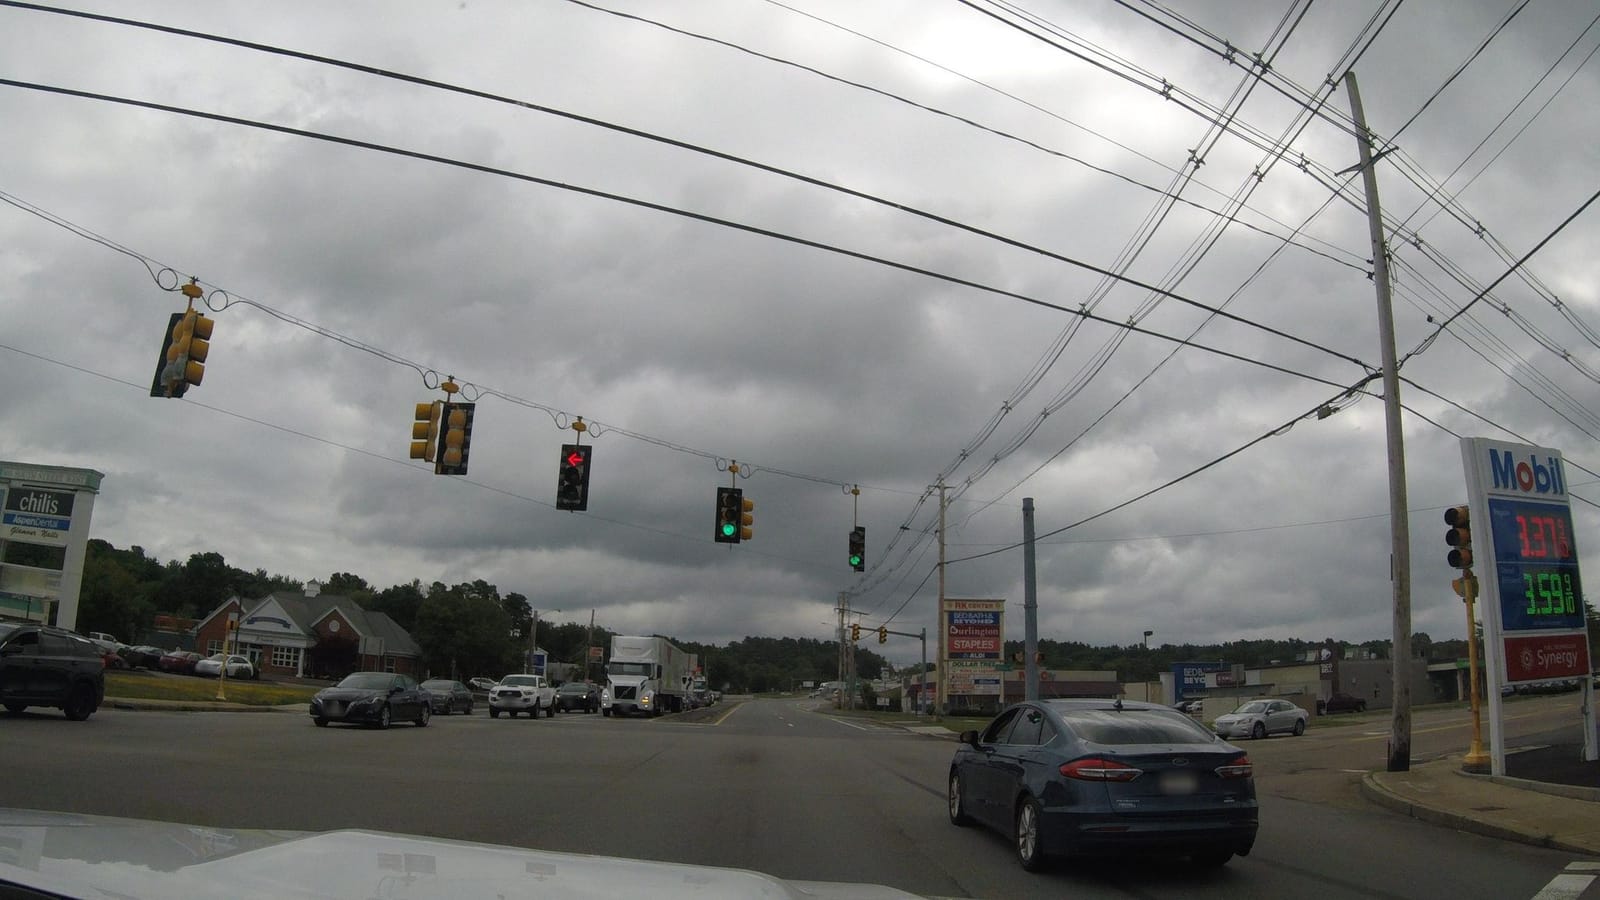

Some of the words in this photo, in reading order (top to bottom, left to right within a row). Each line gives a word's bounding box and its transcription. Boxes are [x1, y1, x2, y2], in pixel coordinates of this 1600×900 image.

[1489, 448, 1564, 495] Mobil
[1516, 515, 1559, 557] 3.37
[1523, 573, 1564, 615] 3.59
[949, 625, 998, 636] Burlington
[953, 640, 994, 649] STAPLES
[1537, 649, 1578, 672] Synergy
